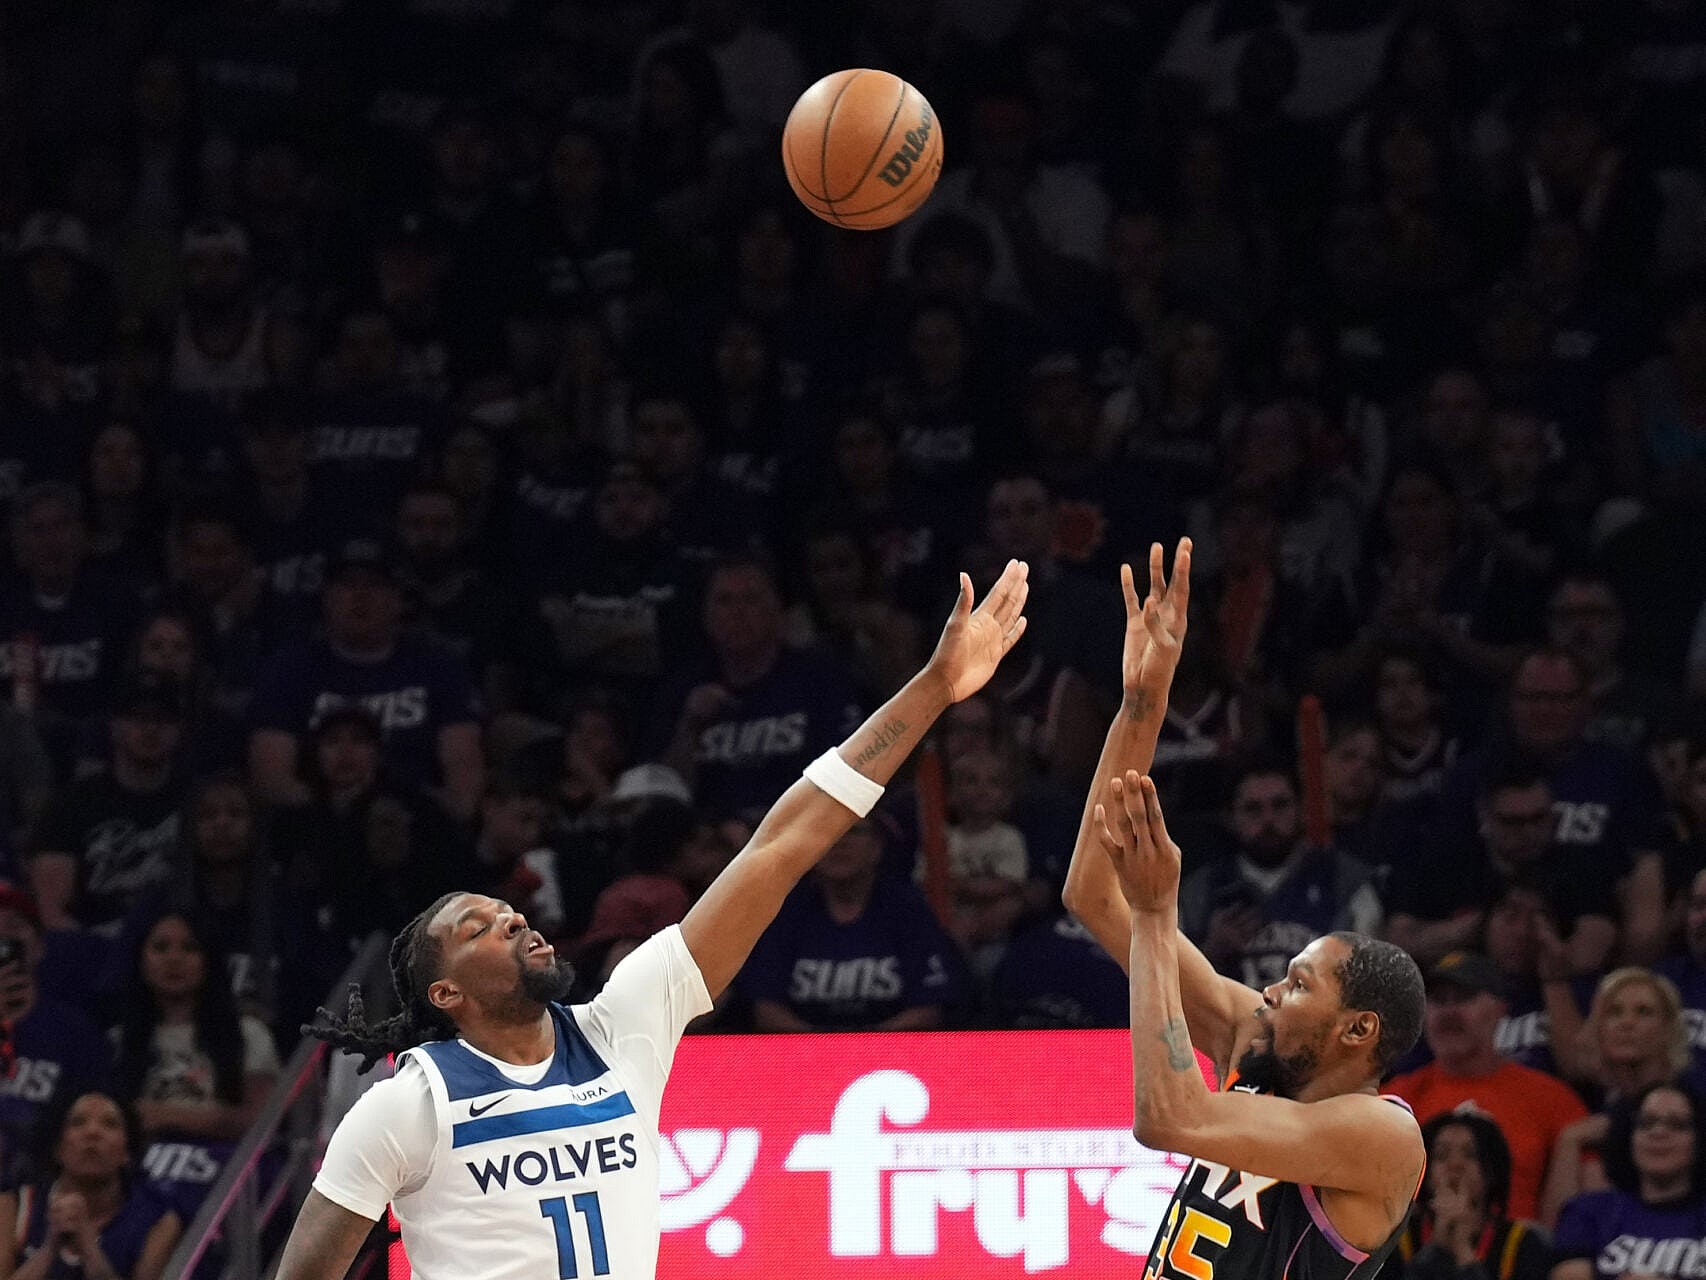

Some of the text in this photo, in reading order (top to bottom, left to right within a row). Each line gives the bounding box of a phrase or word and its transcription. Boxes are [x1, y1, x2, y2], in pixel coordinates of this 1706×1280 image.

[790, 954, 903, 1001] SUNS
[465, 1132, 637, 1196] WOLVES
[783, 1069, 1190, 1275] fry's
[538, 1190, 612, 1280] 11
